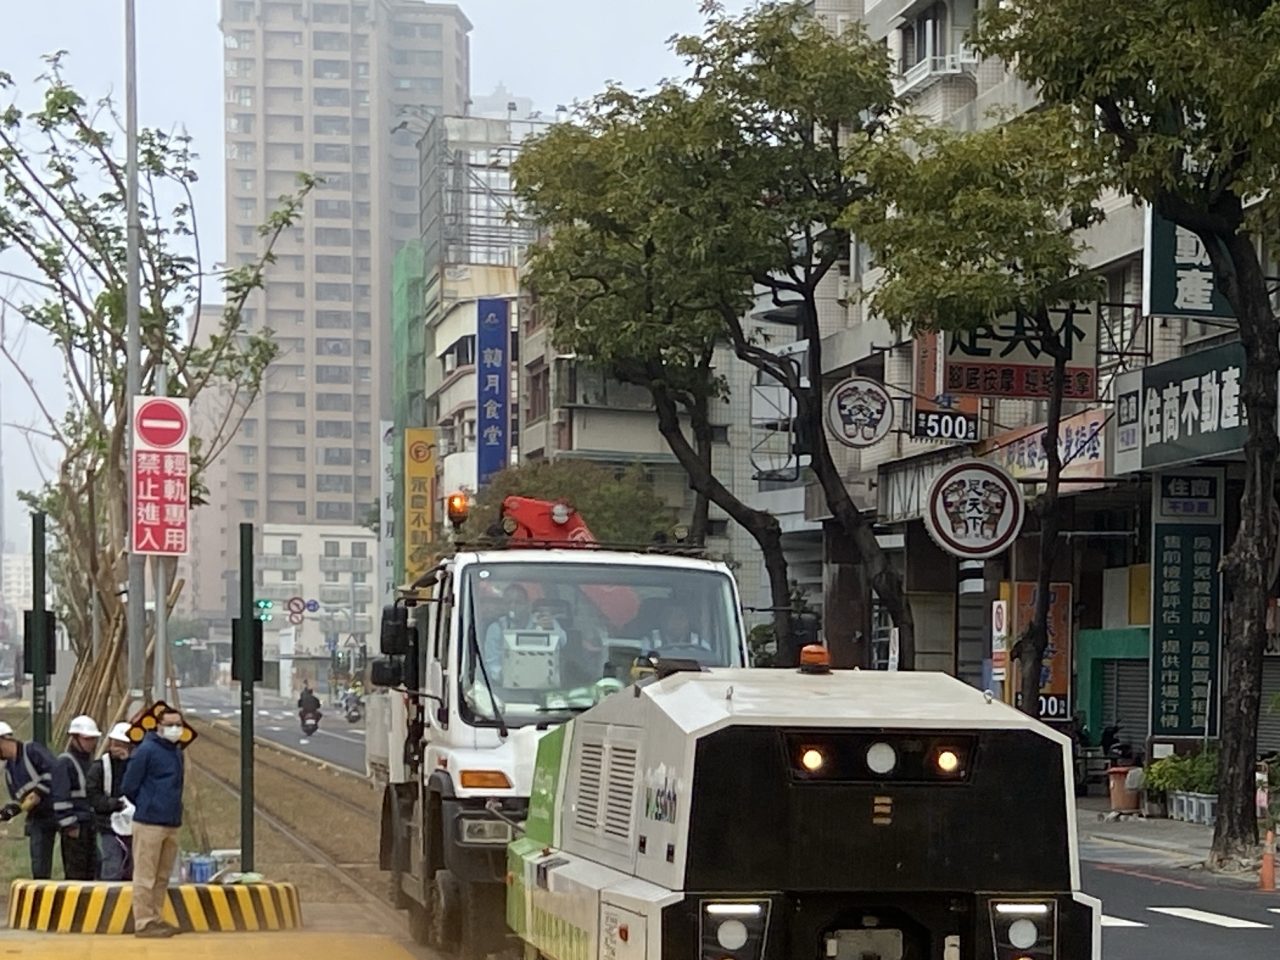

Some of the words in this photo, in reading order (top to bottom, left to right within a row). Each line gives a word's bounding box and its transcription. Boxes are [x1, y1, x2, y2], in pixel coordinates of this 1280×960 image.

[926, 414, 968, 439] 500
[1143, 366, 1241, 448] 住商不動產
[137, 452, 161, 551] 禁止進入
[163, 454, 187, 552] 輕軌專用
[1167, 478, 1211, 497] 住商
